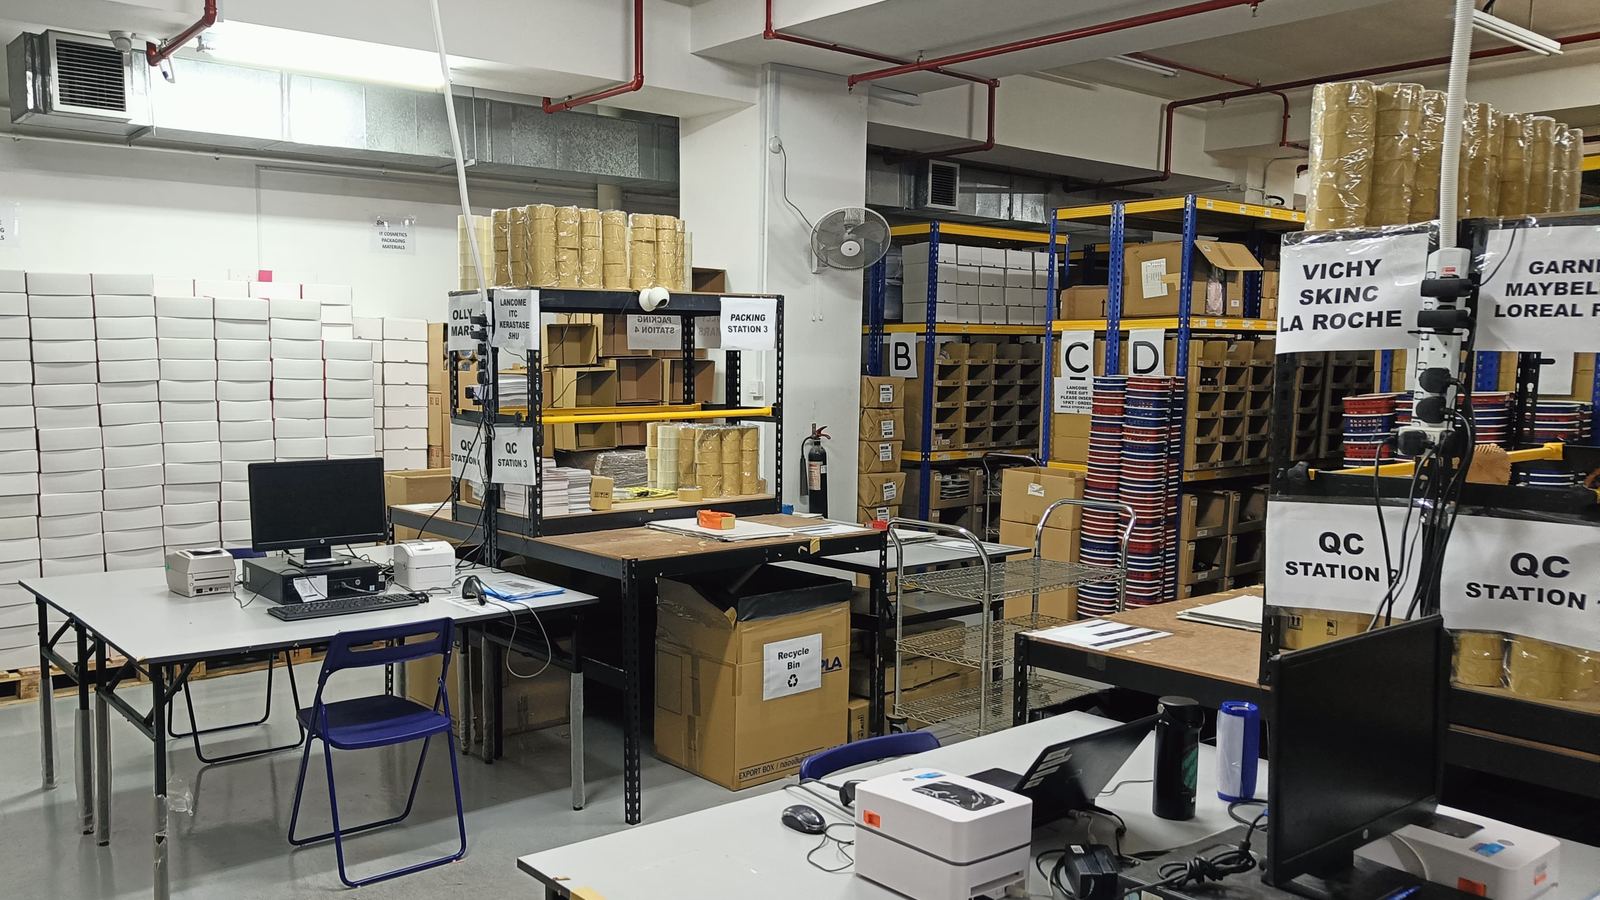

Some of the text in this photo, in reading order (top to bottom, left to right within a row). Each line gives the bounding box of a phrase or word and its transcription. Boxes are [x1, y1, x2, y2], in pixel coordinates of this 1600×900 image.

[1302, 258, 1383, 280] VICHY
[1298, 285, 1380, 306] SKINC
[1505, 281, 1599, 297] MAYBEL
[499, 298, 527, 307] LANCOME
[452, 308, 473, 321] OLLY
[508, 309, 518, 318] ITC
[730, 313, 766, 322] PACKING
[1494, 303, 1584, 318] LOREAL
[499, 321, 530, 330] KERASTASE
[1279, 315, 1304, 333] LA
[1312, 309, 1402, 331] ROCHE
[507, 331, 520, 340] SHU
[727, 325, 762, 333] STATION
[894, 341, 912, 371] B
[1065, 341, 1089, 373] C
[1132, 340, 1160, 374] D
[460, 439, 473, 451] QC
[505, 442, 518, 454] QC
[497, 458, 528, 468] STATION 3
[1318, 531, 1365, 556] QC
[1285, 560, 1380, 582] STATION
[1509, 552, 1571, 579] QC
[1465, 582, 1587, 611] STATION
[777, 647, 810, 661] Recycle
[787, 661, 801, 670] Bin
[738, 768, 761, 780] EXPORT
[762, 764, 775, 773] BOX
